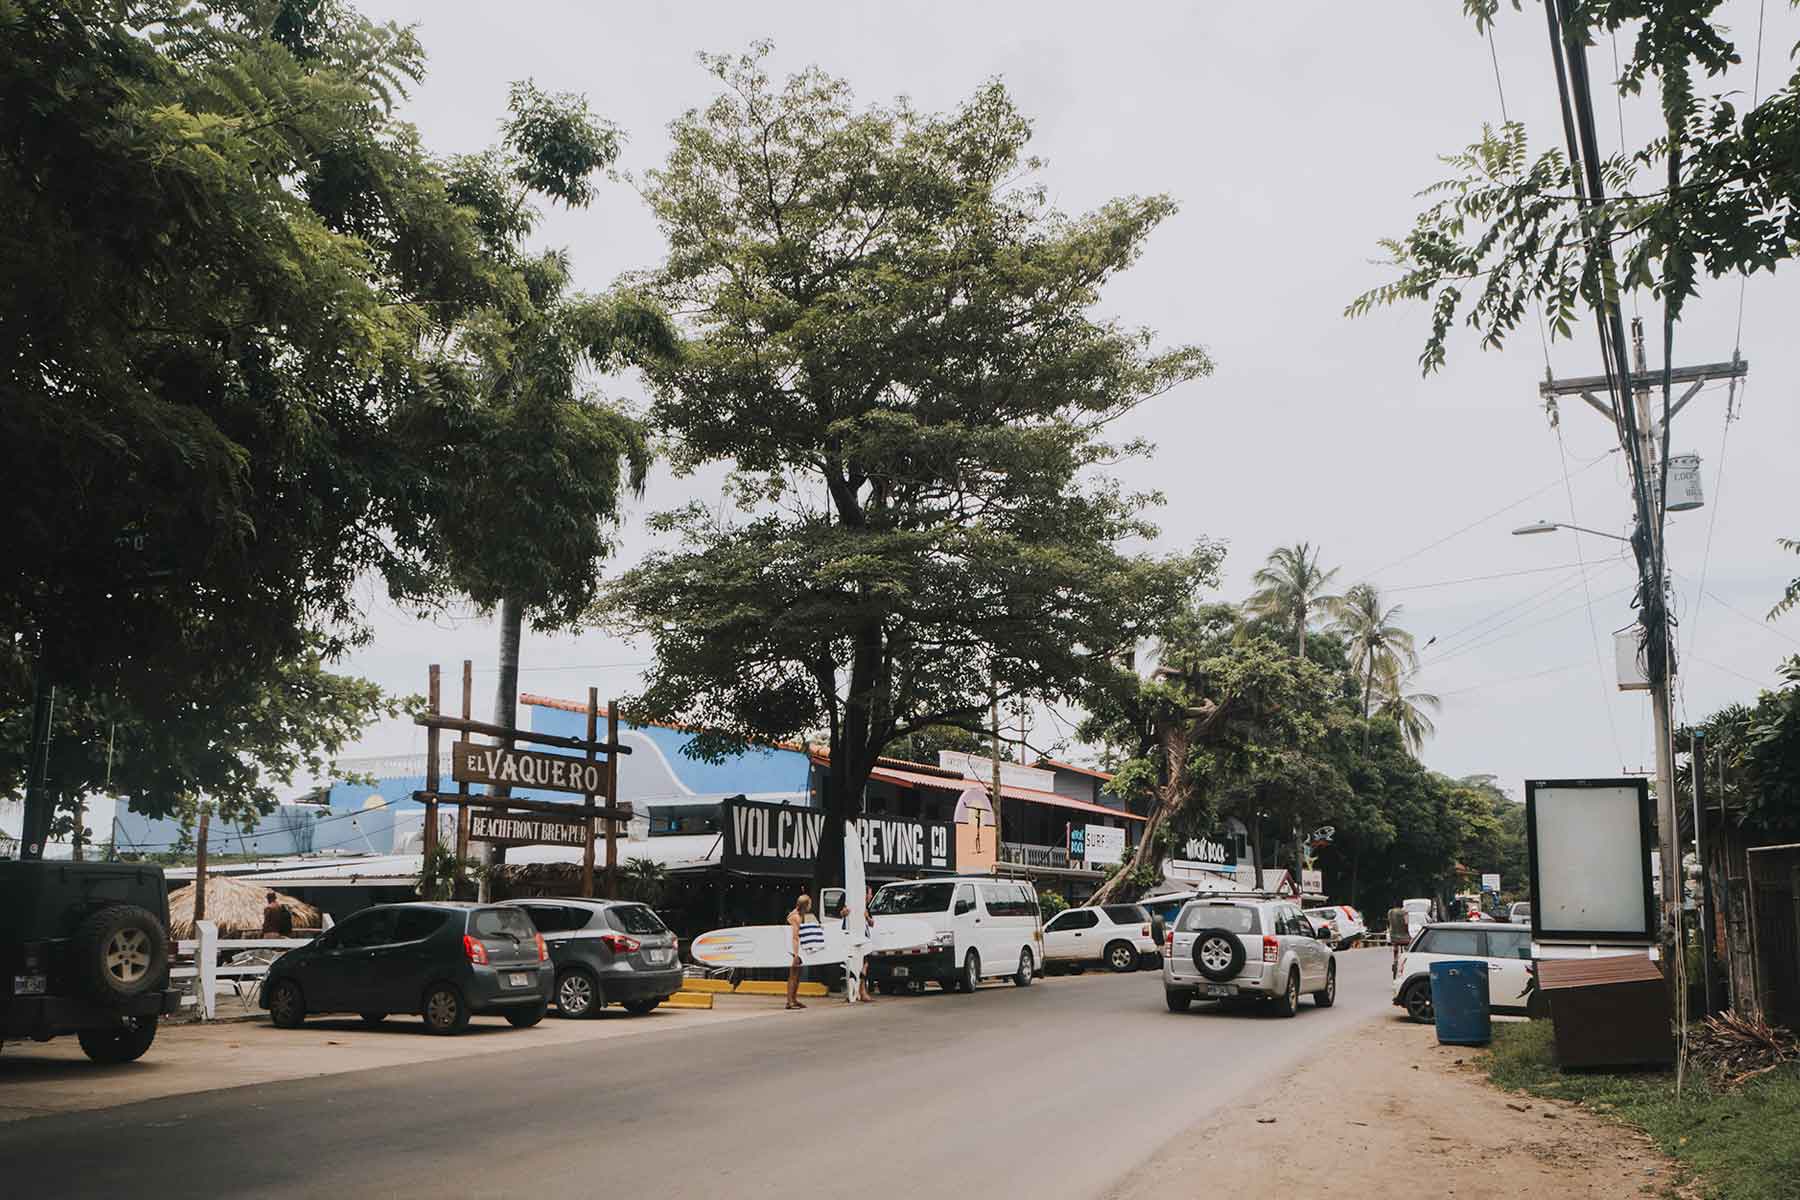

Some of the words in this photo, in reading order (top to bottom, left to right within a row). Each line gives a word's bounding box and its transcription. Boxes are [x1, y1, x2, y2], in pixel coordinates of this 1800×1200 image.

[467, 755, 485, 772] EL
[485, 749, 598, 791] VAQUERO
[472, 816, 540, 841] BEACHFRONT
[541, 823, 586, 844] BREWPUB
[732, 806, 826, 860] VOLCAN
[854, 817, 924, 865] REWING
[931, 826, 946, 858] CO
[1086, 832, 1105, 848] SURF
